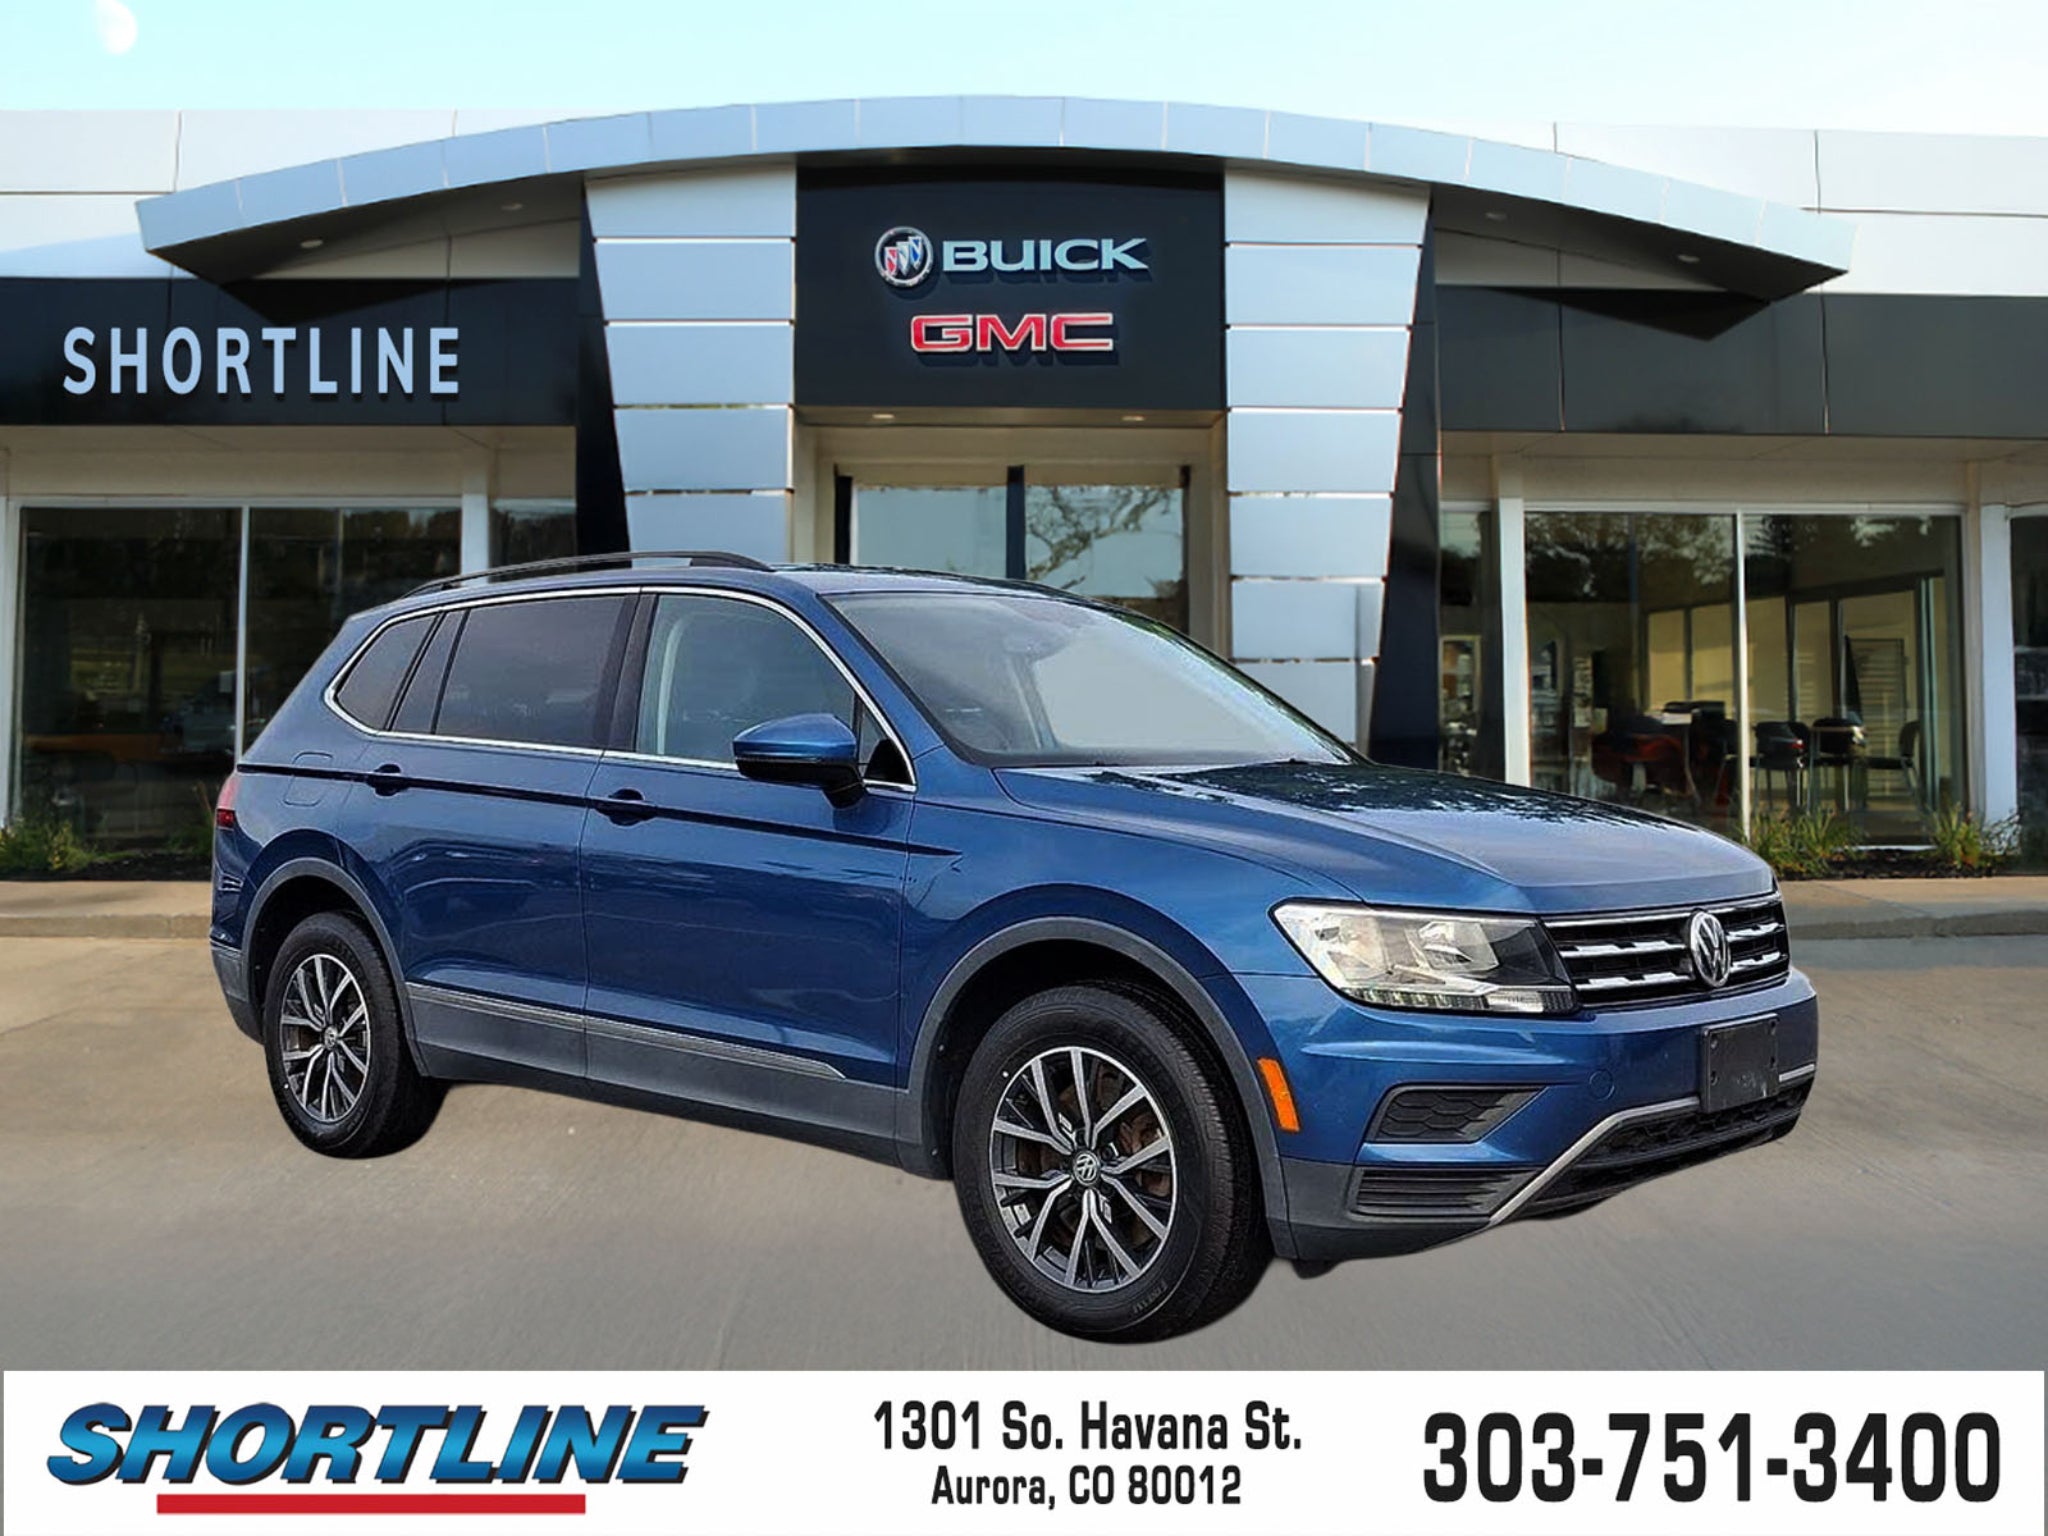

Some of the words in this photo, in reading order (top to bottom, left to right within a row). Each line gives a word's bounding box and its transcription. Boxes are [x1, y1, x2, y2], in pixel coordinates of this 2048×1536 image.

[942, 237, 1149, 273] BUICK
[910, 312, 1114, 352] GMC
[63, 326, 460, 396] SHORTLINE
